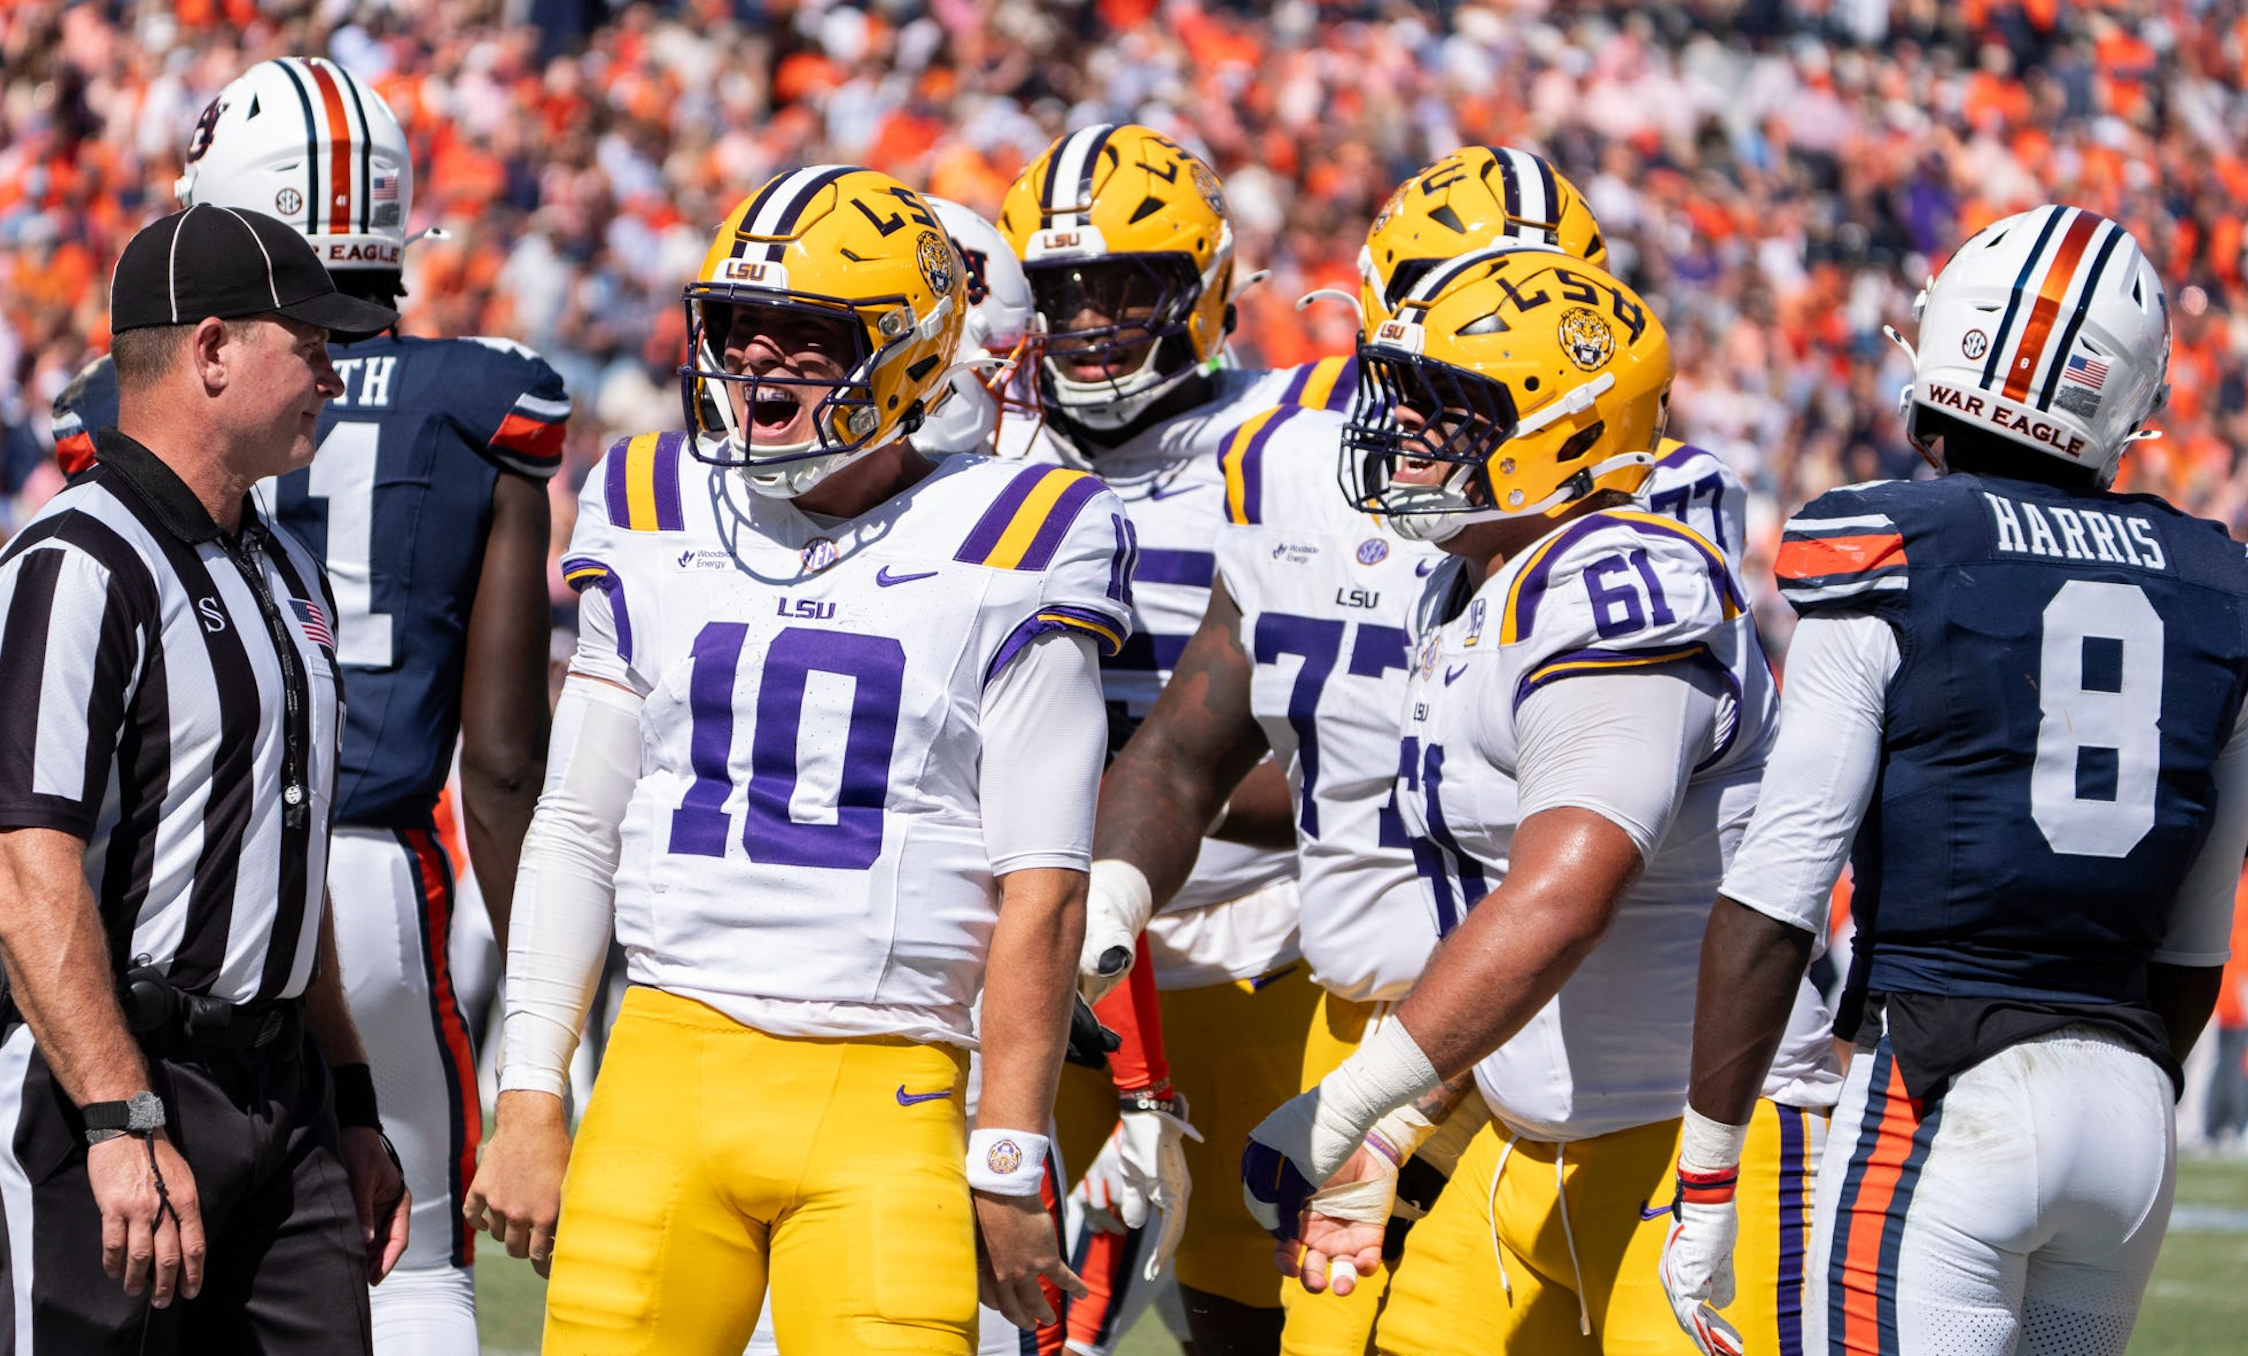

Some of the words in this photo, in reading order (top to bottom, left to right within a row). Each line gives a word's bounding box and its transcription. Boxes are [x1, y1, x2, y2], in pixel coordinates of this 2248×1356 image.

[277, 189, 302, 214] SEC
[1043, 232, 1080, 249] LSU
[329, 244, 401, 263] EAGLE
[725, 261, 766, 281] LSU
[1496, 268, 1646, 348] LSU
[1380, 323, 1406, 341] LSU
[1963, 331, 1987, 358] SEC
[1929, 383, 1985, 417] WAR
[1990, 404, 2085, 459] EAGLE
[1650, 471, 1729, 553] 77
[1983, 492, 2165, 570] HARRIS
[696, 559, 727, 570] Energy
[1357, 540, 1387, 565] SEC
[1336, 587, 1380, 609] LSU
[1583, 548, 1676, 640] 61
[777, 597, 836, 620] LSU
[1413, 701, 1430, 723] LSU
[2030, 579, 2165, 858] 8
[667, 621, 906, 870] 10
